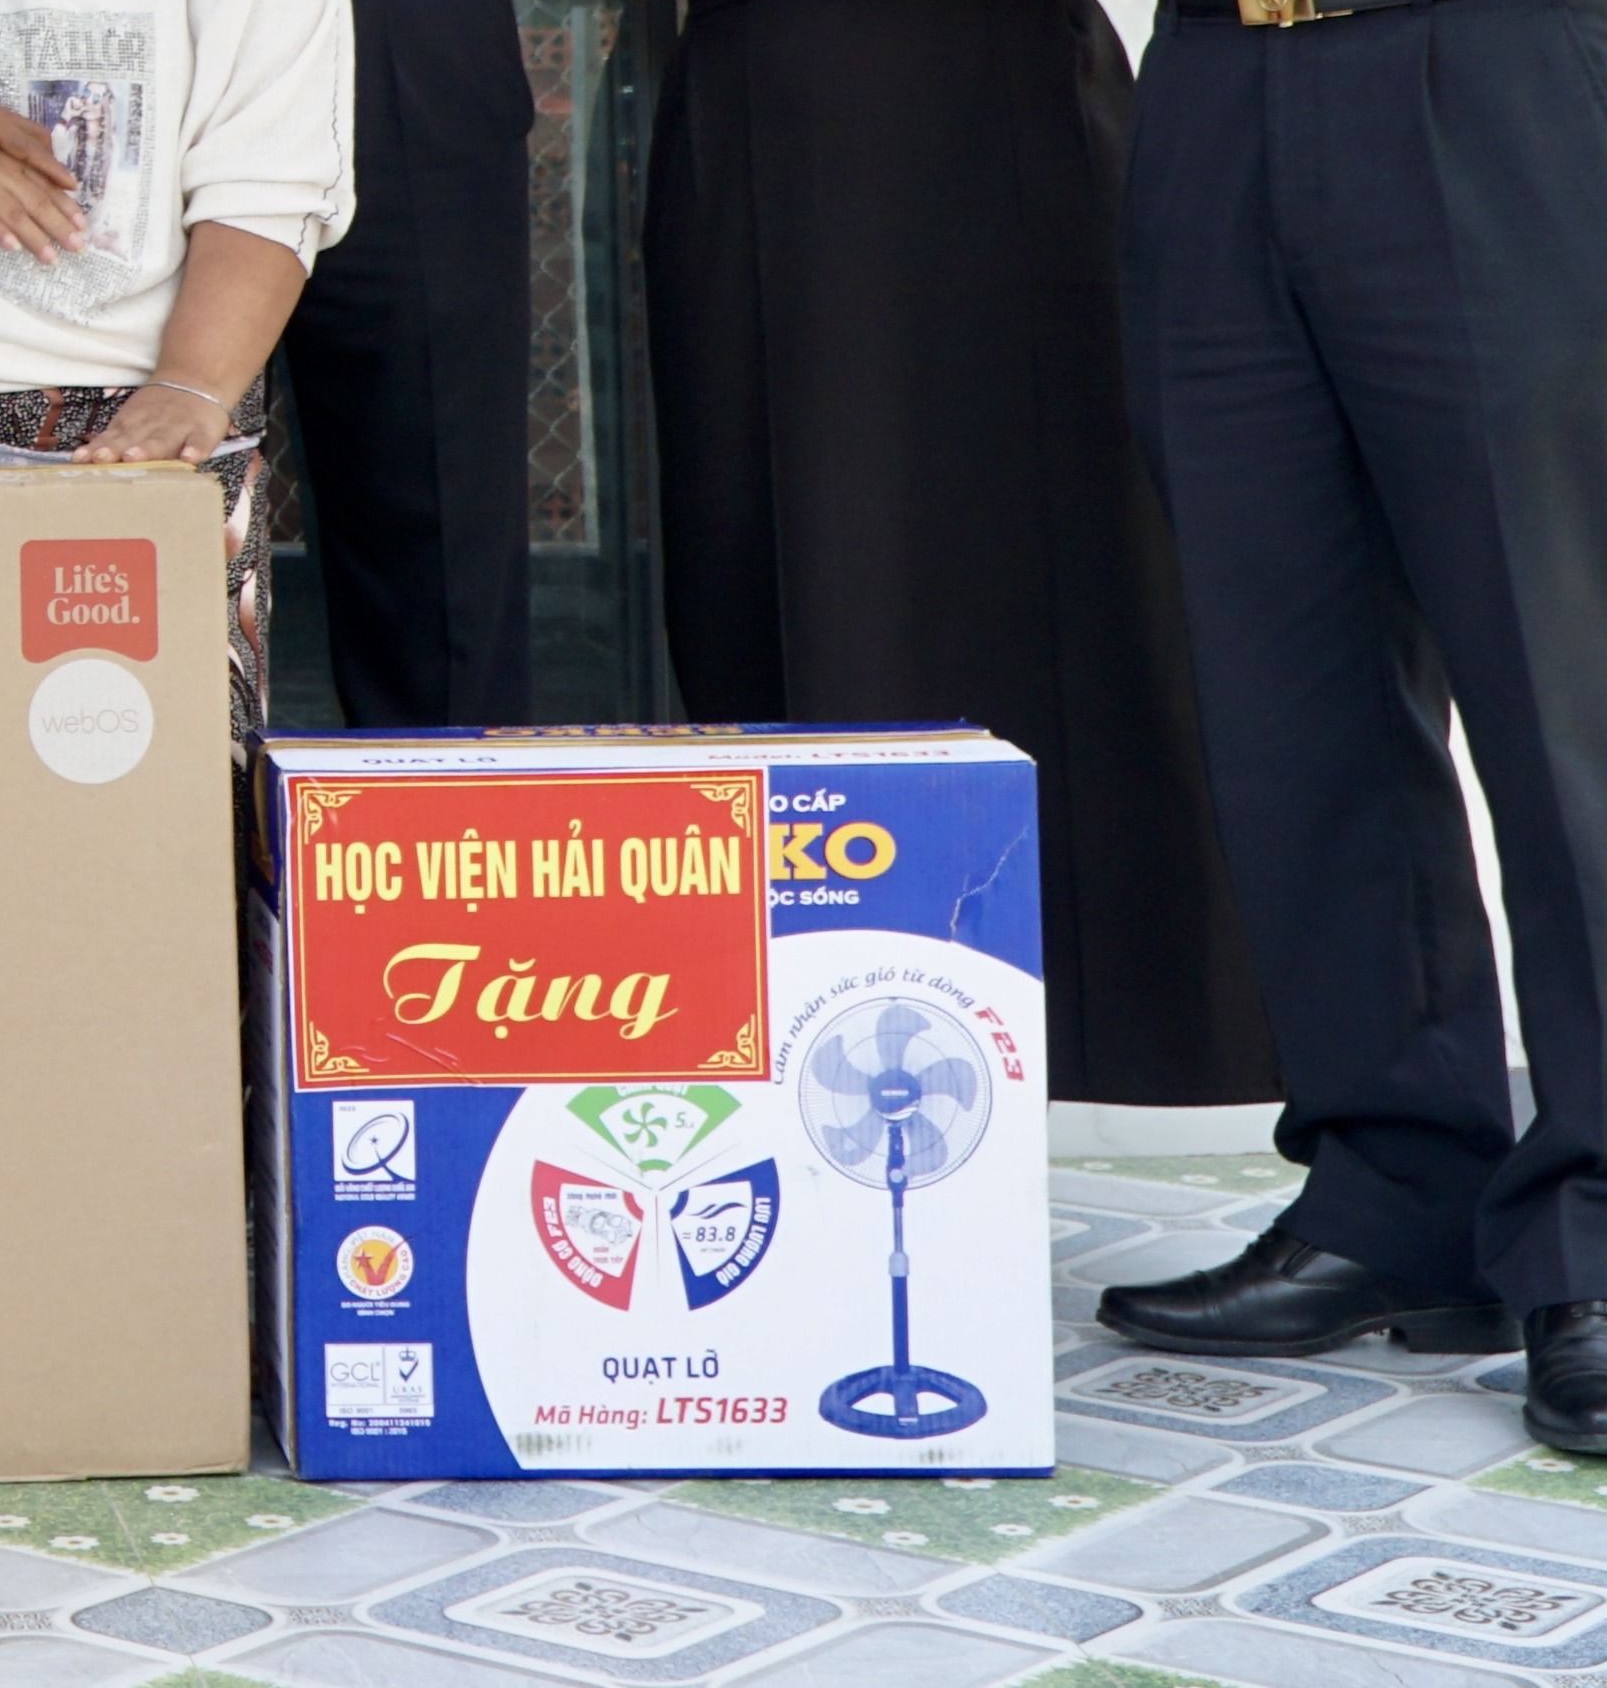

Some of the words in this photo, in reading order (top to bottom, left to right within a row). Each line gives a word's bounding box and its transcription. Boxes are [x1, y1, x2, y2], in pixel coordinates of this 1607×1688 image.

[47, 596, 140, 625] Good.
[42, 709, 139, 734] webOS
[792, 788, 847, 812] CẤP
[315, 841, 403, 914] HỌC
[416, 828, 518, 912] VIỆN
[531, 818, 605, 899] HẢI
[620, 824, 741, 904] QUÂN
[799, 885, 860, 906] SỐNG
[383, 943, 679, 1040] Tặng
[928, 975, 976, 1010] dòng
[974, 1005, 1026, 1082] F23
[695, 1226, 737, 1243] 83.8
[602, 1356, 677, 1386] QUẠT
[534, 1405, 571, 1425] Mã
[579, 1404, 648, 1430] Hàng:
[656, 1397, 788, 1424] LTS1633
